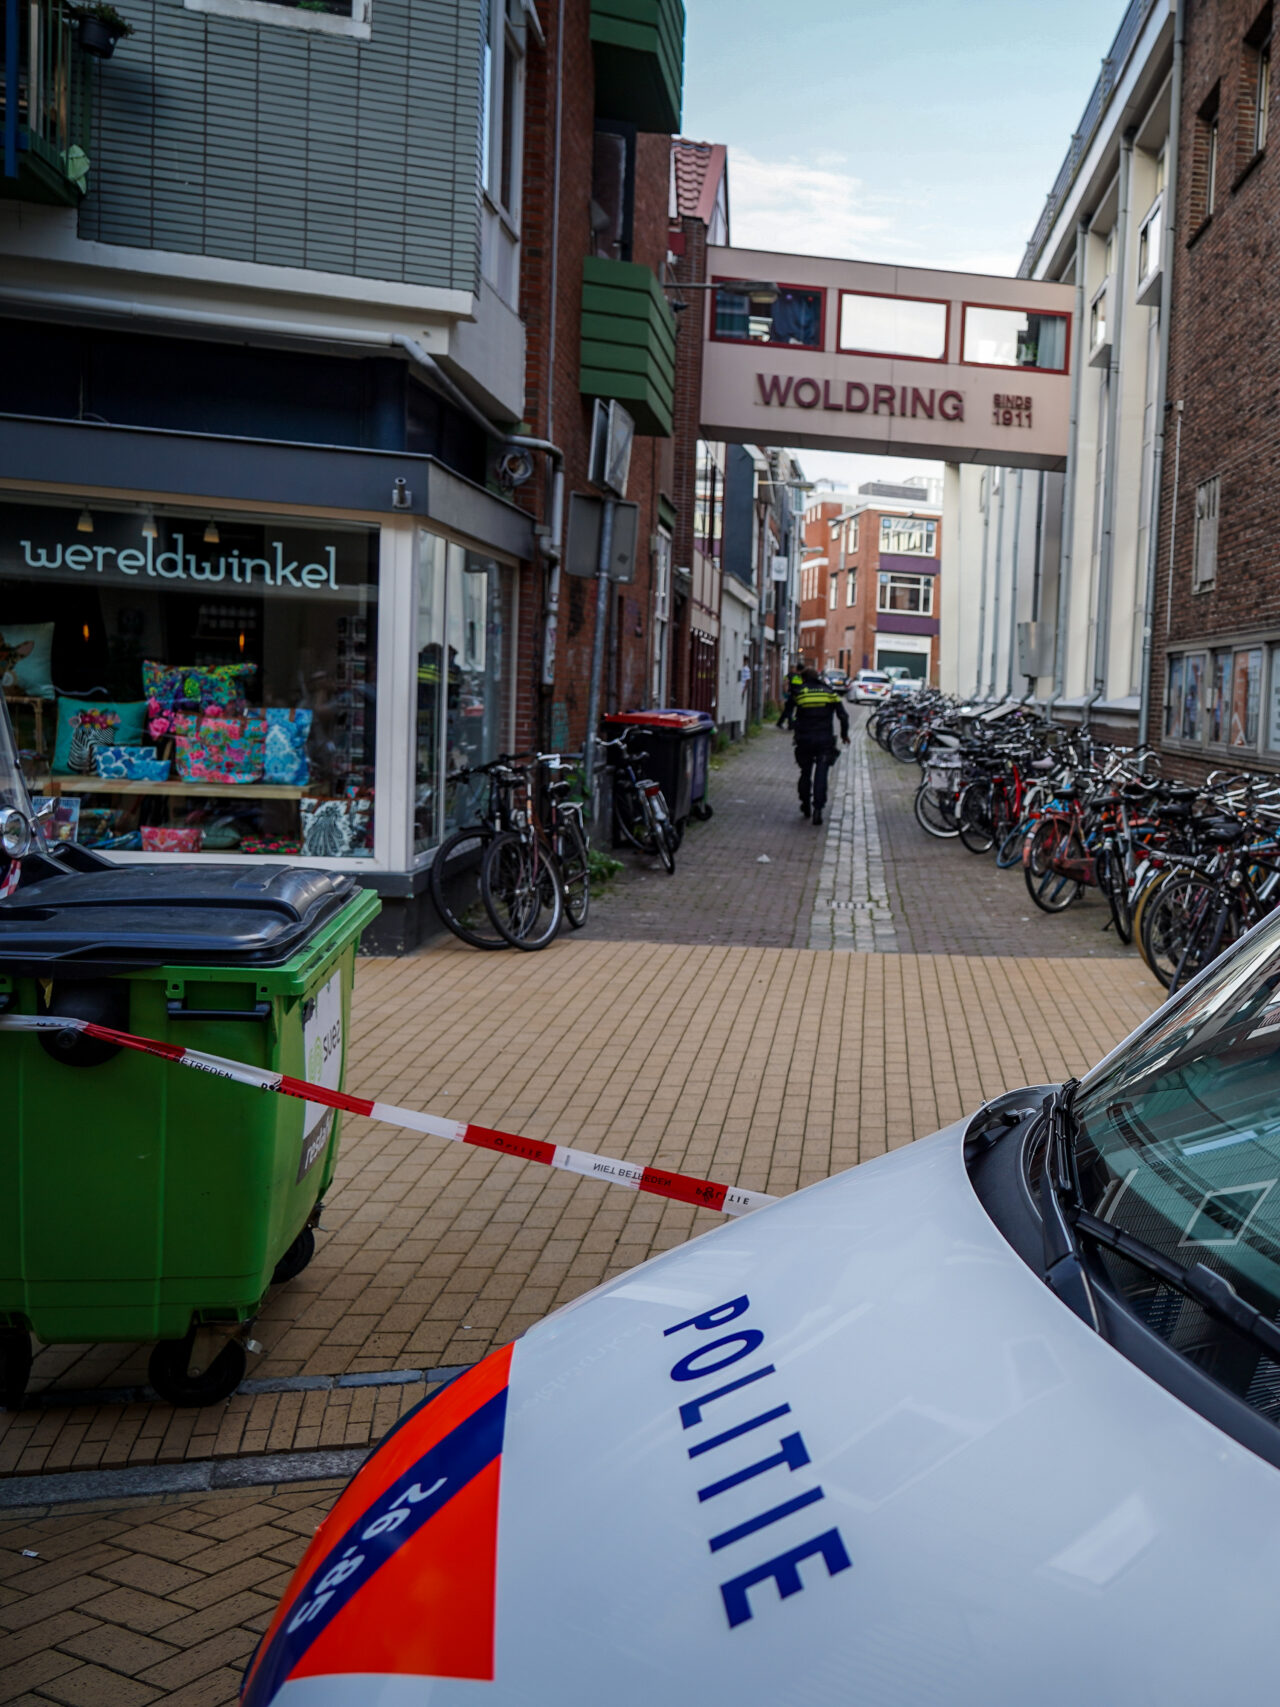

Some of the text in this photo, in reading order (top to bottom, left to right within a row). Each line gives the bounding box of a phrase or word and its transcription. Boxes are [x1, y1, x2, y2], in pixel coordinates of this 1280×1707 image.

[756, 373, 965, 423] WOLDRING
[993, 393, 1032, 411] SINDS
[993, 409, 1033, 429] 1911
[20, 531, 339, 591] wereldwinkel
[322, 1019, 342, 1062] suez
[663, 1294, 853, 1630] POLITIE
